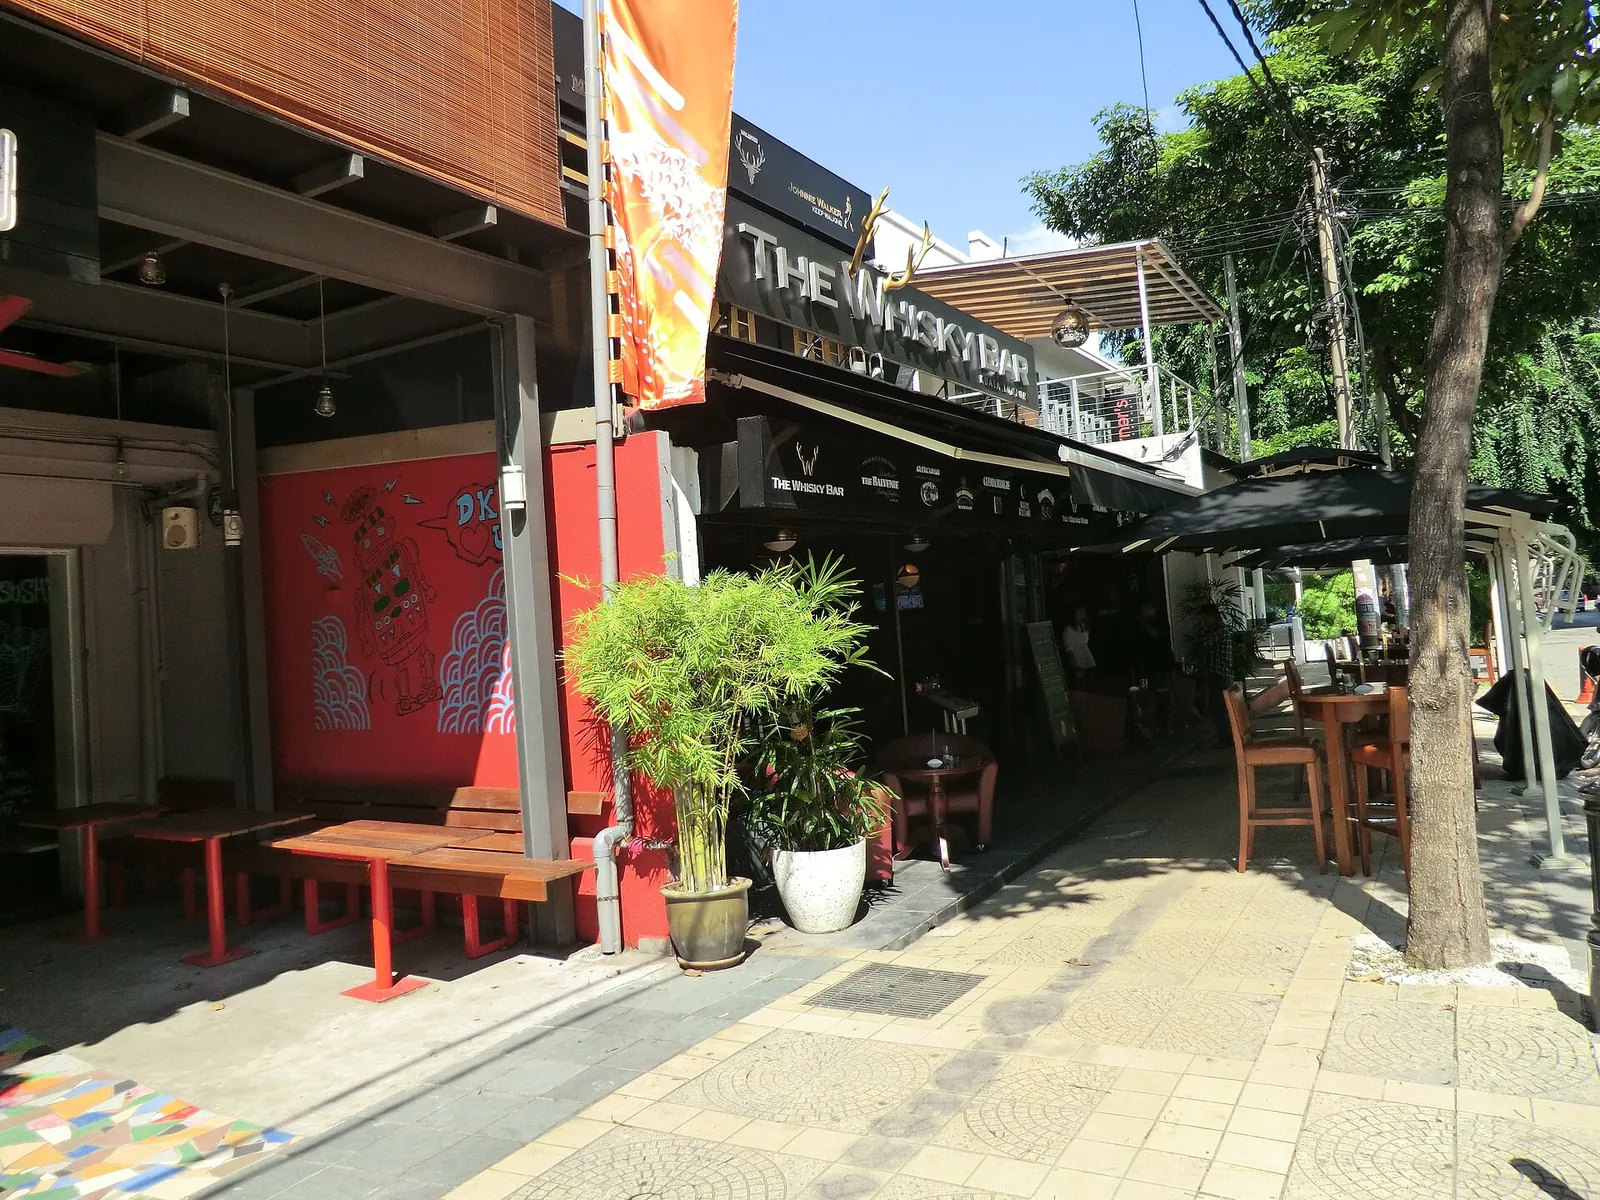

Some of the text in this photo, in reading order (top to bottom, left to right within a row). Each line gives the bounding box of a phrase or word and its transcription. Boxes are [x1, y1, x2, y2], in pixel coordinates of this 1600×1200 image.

[817, 197, 844, 219] WALKER
[736, 222, 1030, 386] THE WHISKY BAR
[771, 476, 844, 497] THE WHISKY BAR
